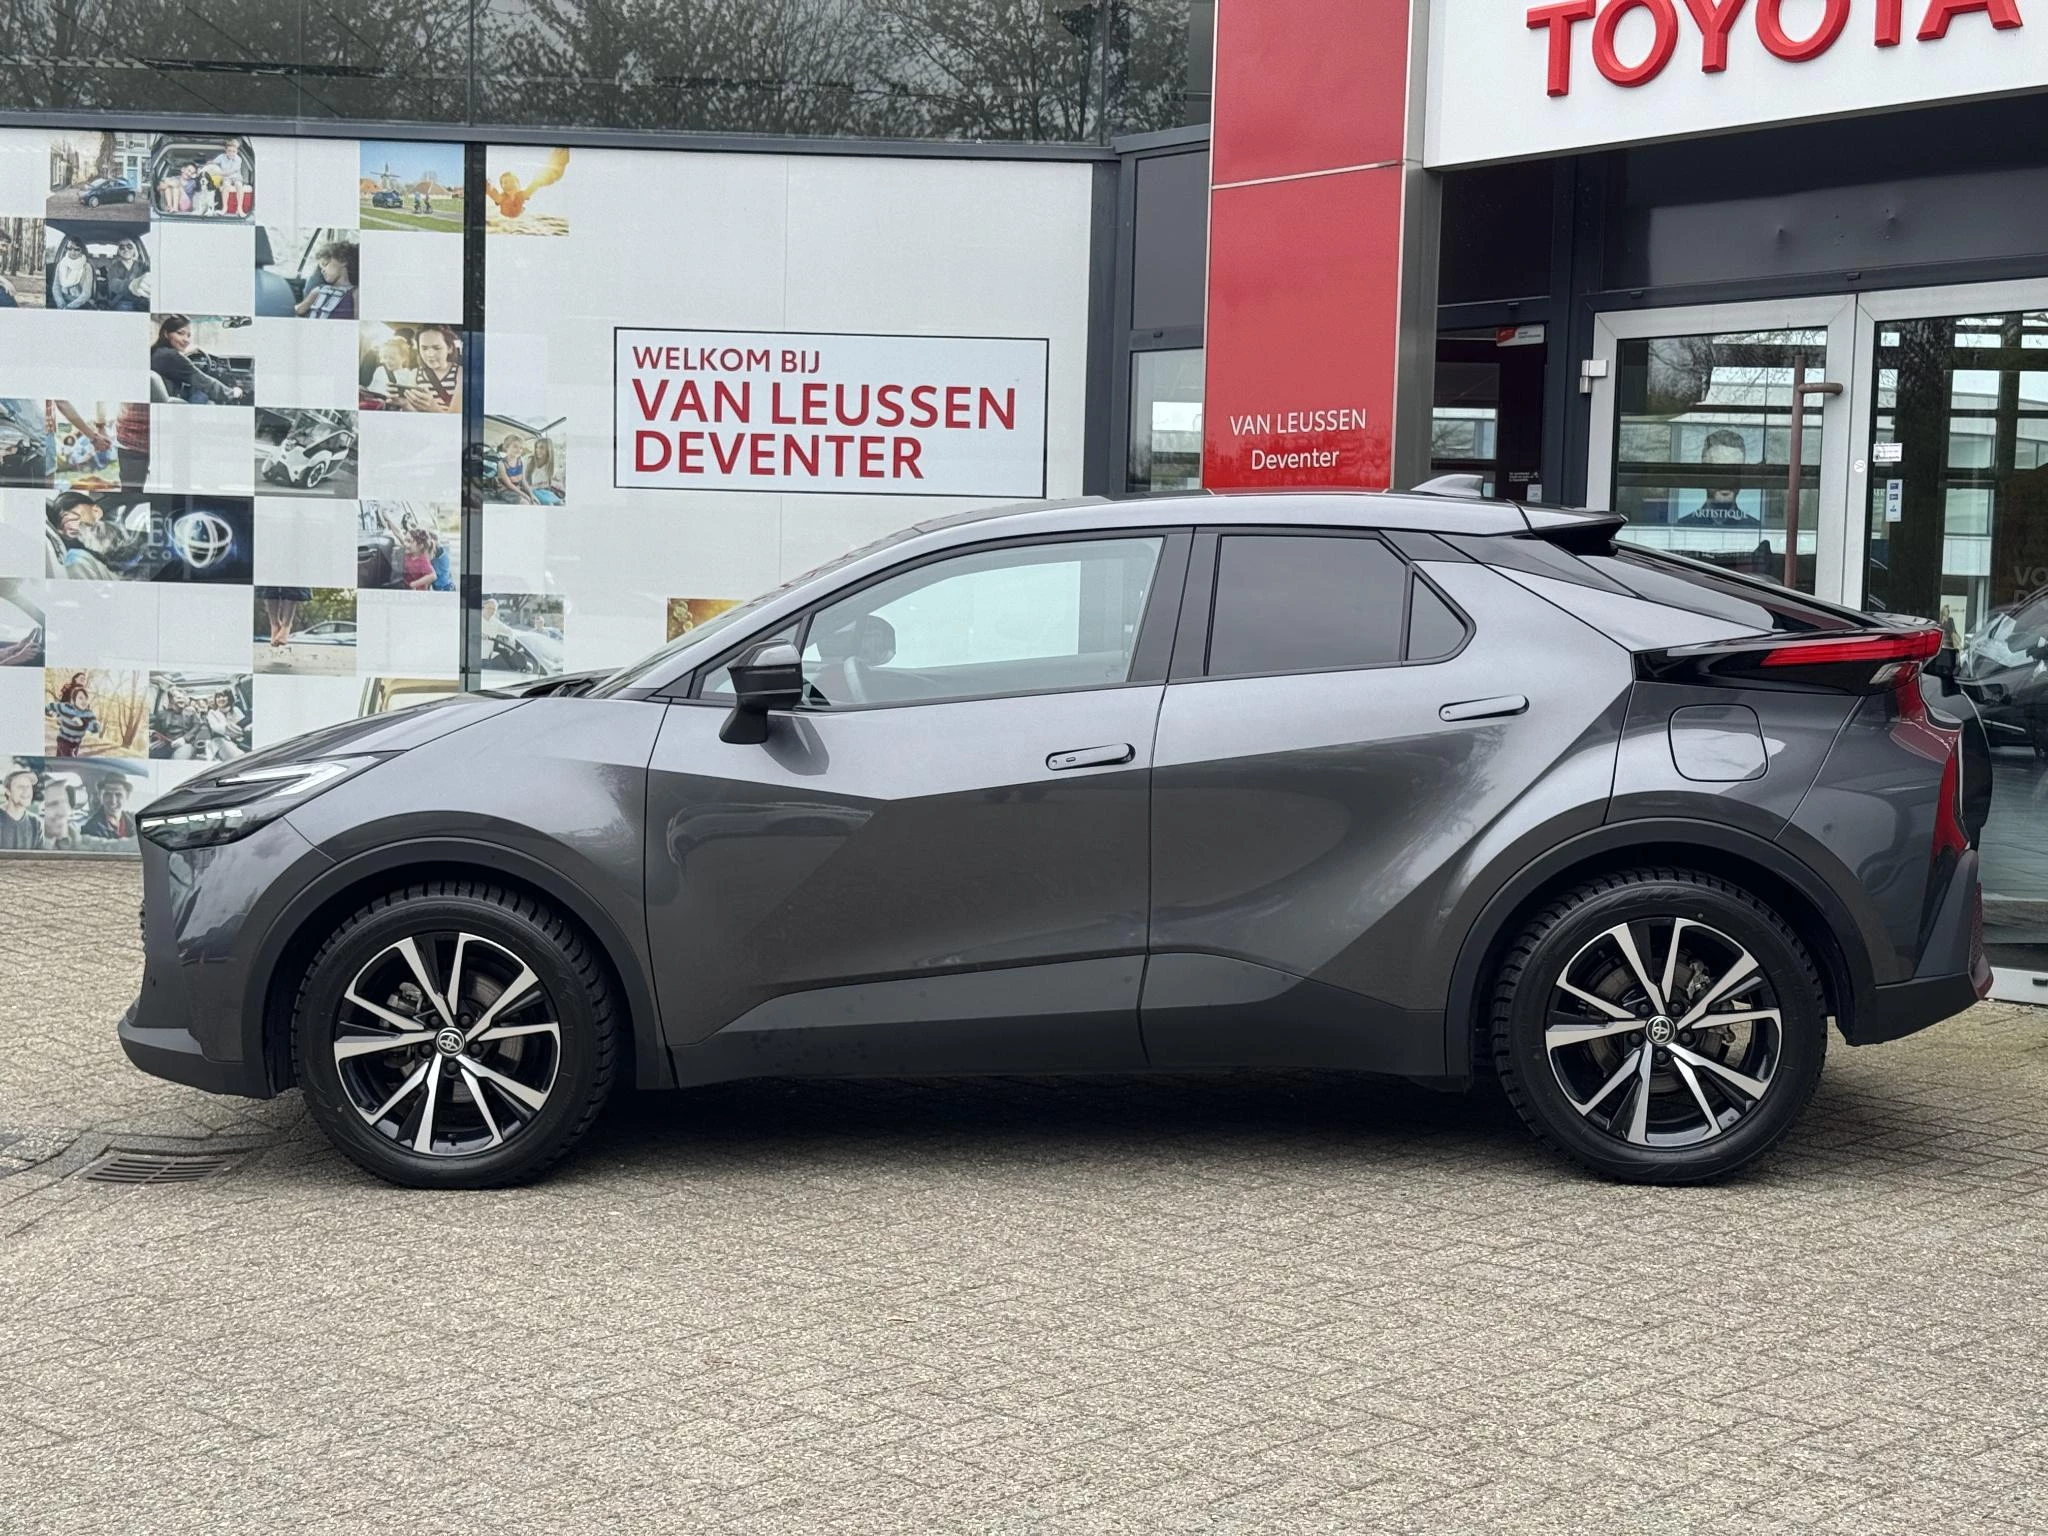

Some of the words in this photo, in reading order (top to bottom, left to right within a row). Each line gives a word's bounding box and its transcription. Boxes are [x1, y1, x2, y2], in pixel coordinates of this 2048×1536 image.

[632, 346, 770, 373] WELKOM
[780, 350, 820, 374] BIJ
[632, 378, 751, 424] VAN
[771, 382, 1016, 431] LEUSSEN
[1230, 413, 1271, 436] VAN
[1277, 408, 1366, 434] LEUSSEN
[634, 430, 925, 479] DEVENTER
[1251, 448, 1340, 470] Deventer
